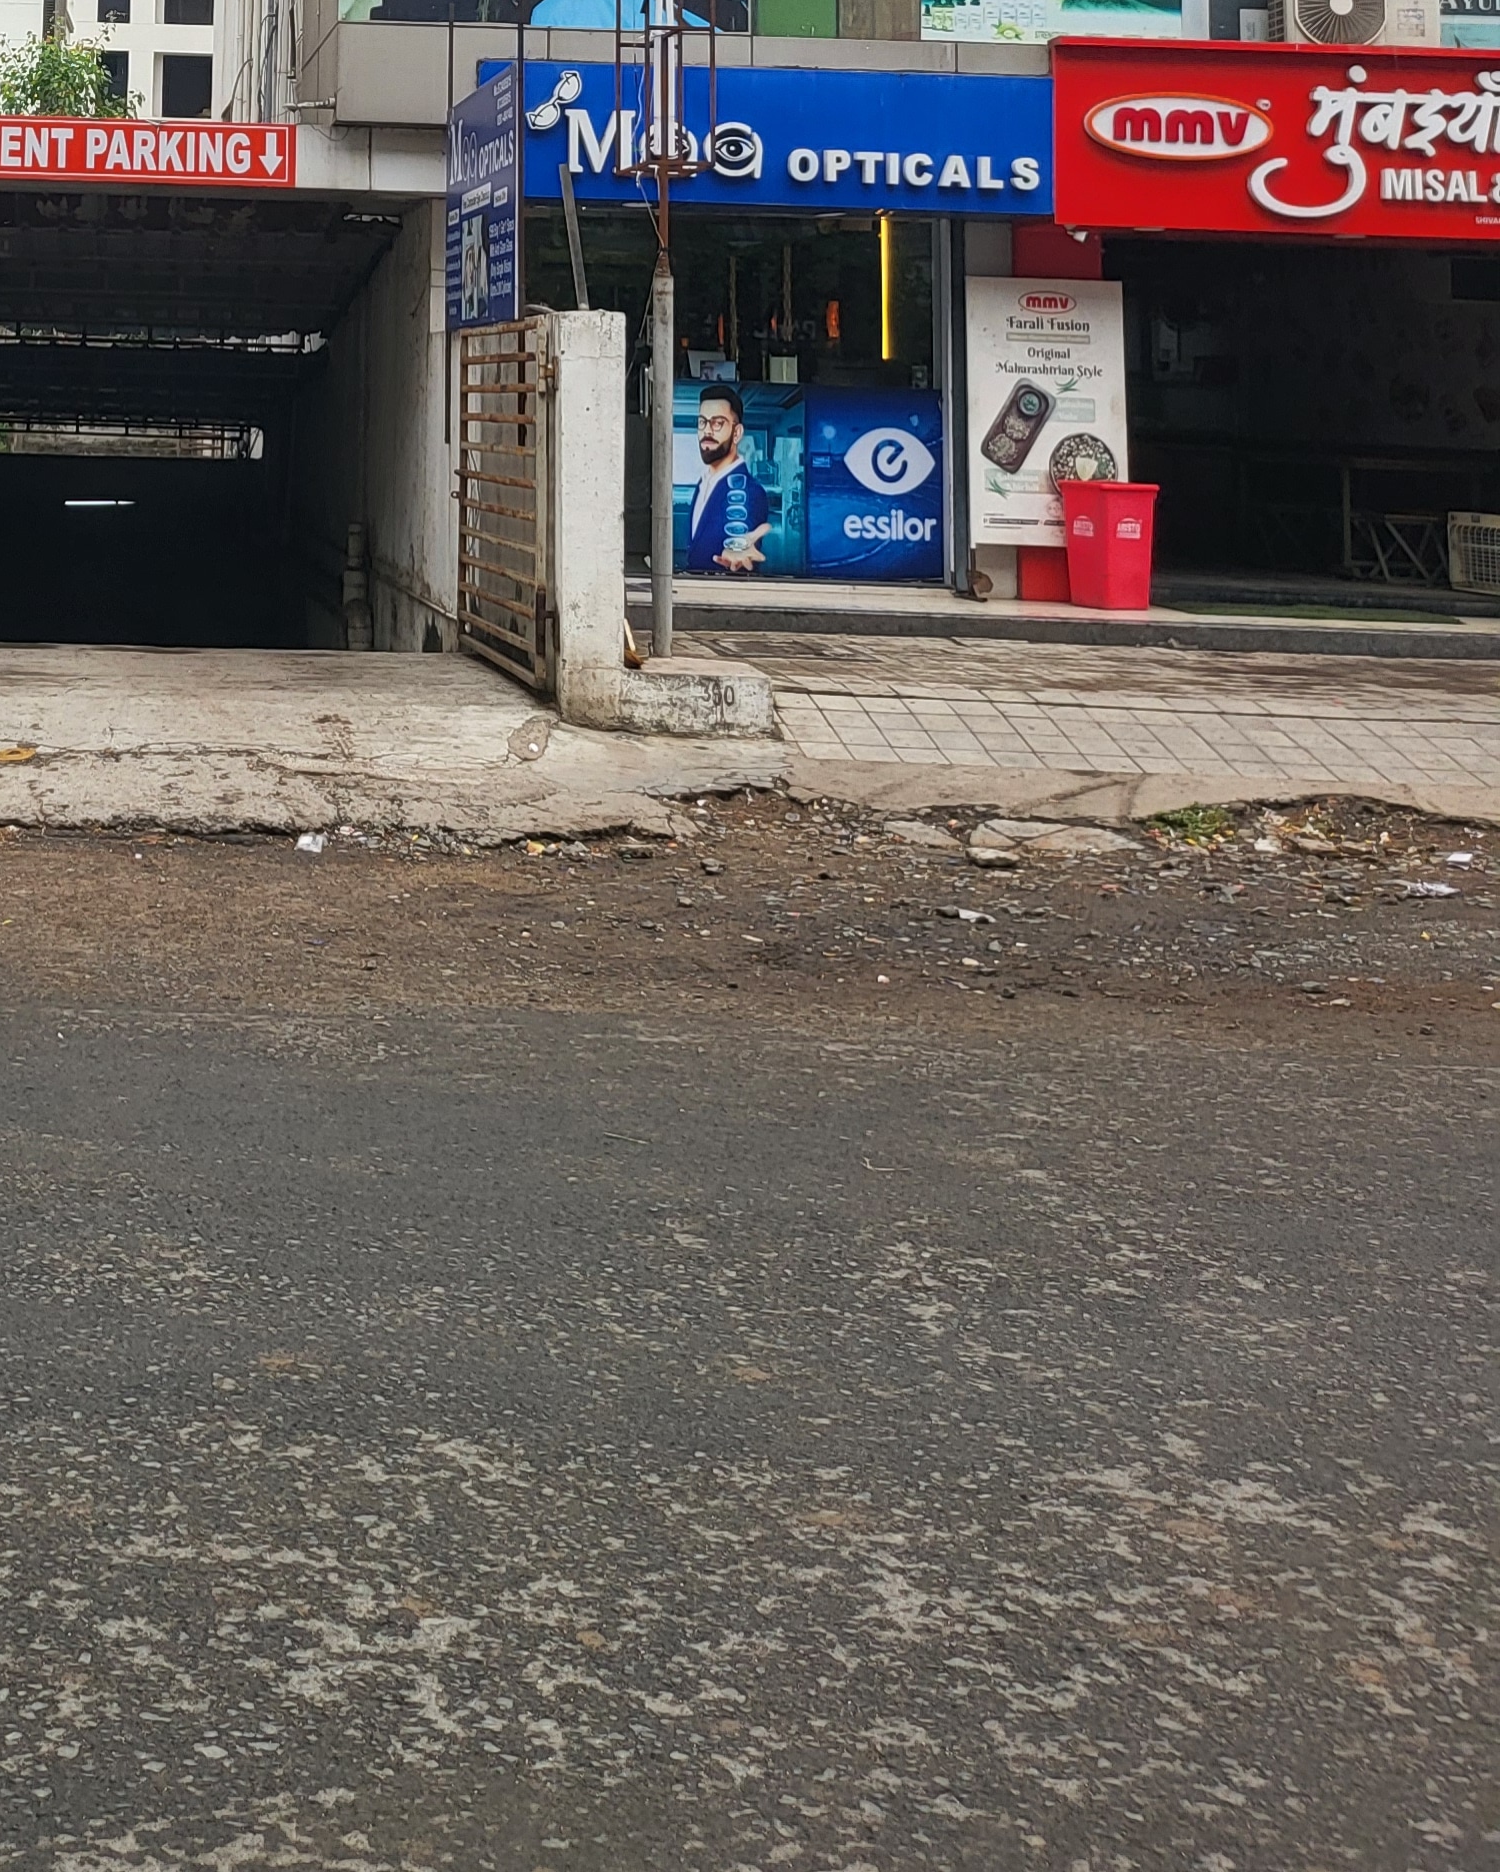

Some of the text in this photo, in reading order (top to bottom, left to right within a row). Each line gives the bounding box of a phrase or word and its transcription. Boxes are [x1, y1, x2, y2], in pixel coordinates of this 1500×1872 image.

[1113, 107, 1251, 146] mmv
[86, 128, 253, 175] PARKING
[478, 130, 515, 179] OPTICALS
[787, 147, 1040, 191] OPTICALS
[1380, 167, 1488, 203] MISAL
[1025, 297, 1069, 309] mmv
[1027, 347, 1071, 360] Original
[1077, 366, 1103, 378] Style
[844, 510, 937, 542] essilor
